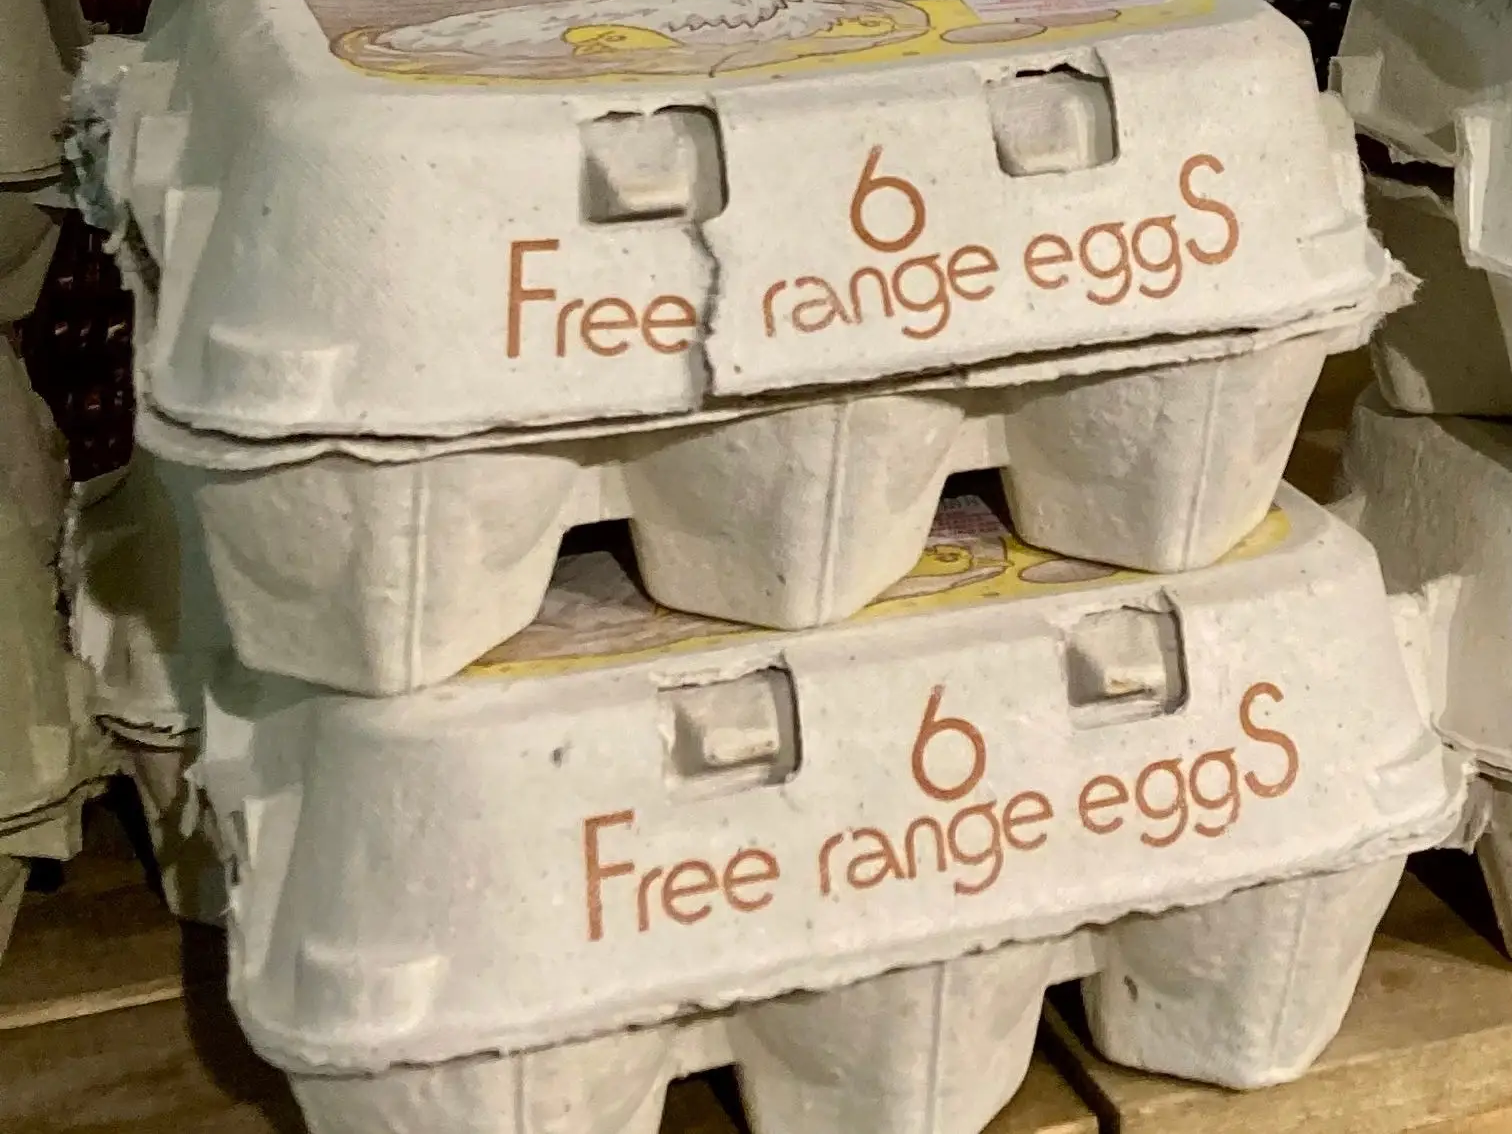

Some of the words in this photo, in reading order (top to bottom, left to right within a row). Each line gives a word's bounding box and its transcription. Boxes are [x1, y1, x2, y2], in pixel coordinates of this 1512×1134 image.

[507, 237, 697, 360] Free
[761, 243, 999, 341] range
[1023, 154, 1241, 308] eggS
[849, 144, 927, 254] 6
[582, 809, 780, 943] Free
[819, 789, 1054, 899] range
[1077, 681, 1299, 848] eggS
[911, 686, 987, 801] 6
